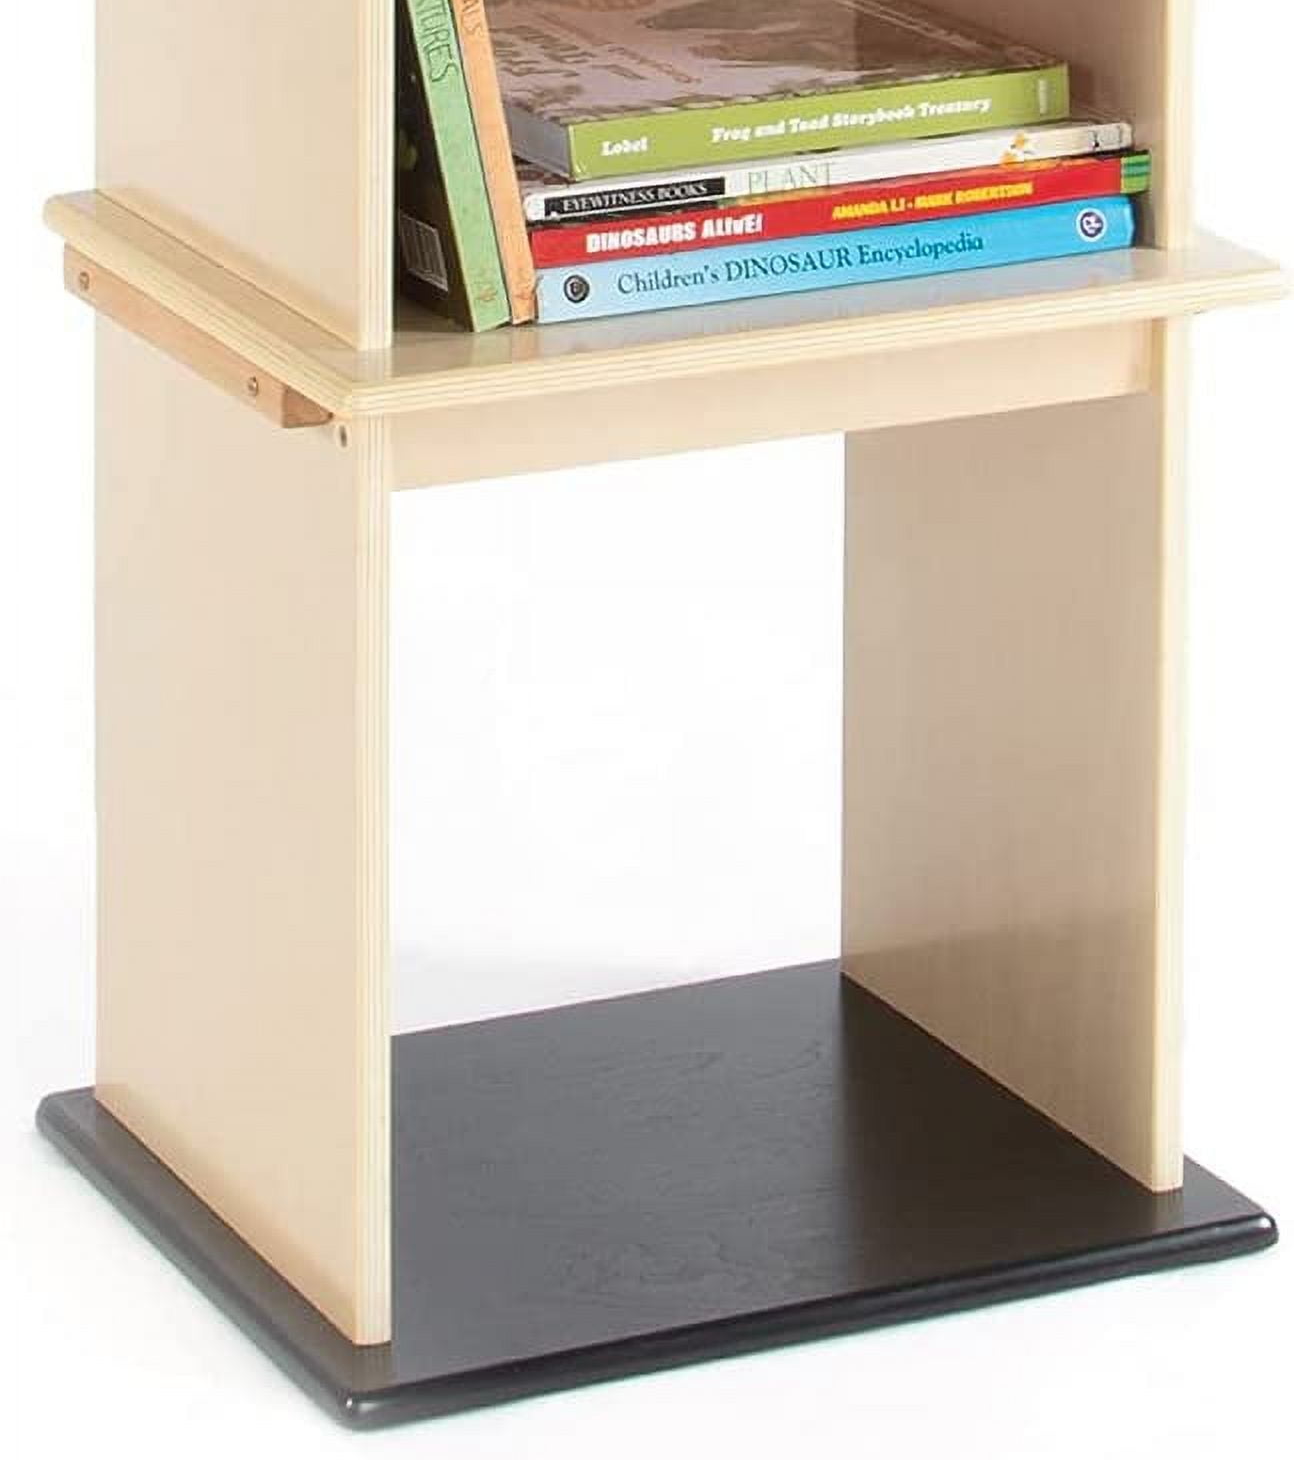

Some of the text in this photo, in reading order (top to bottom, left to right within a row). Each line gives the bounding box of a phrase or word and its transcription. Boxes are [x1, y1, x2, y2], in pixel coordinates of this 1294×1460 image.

[601, 96, 993, 157] Lobel Frog and Toad Storybook Treasury
[748, 161, 833, 195] PLANT
[561, 182, 709, 213] EYEWITNESS BOOKS
[831, 202, 889, 220] AMANDA
[890, 197, 906, 213] LI
[585, 221, 697, 254] DINOSAURS
[616, 231, 985, 296] Children's DINOSAUR Encyclopedia
